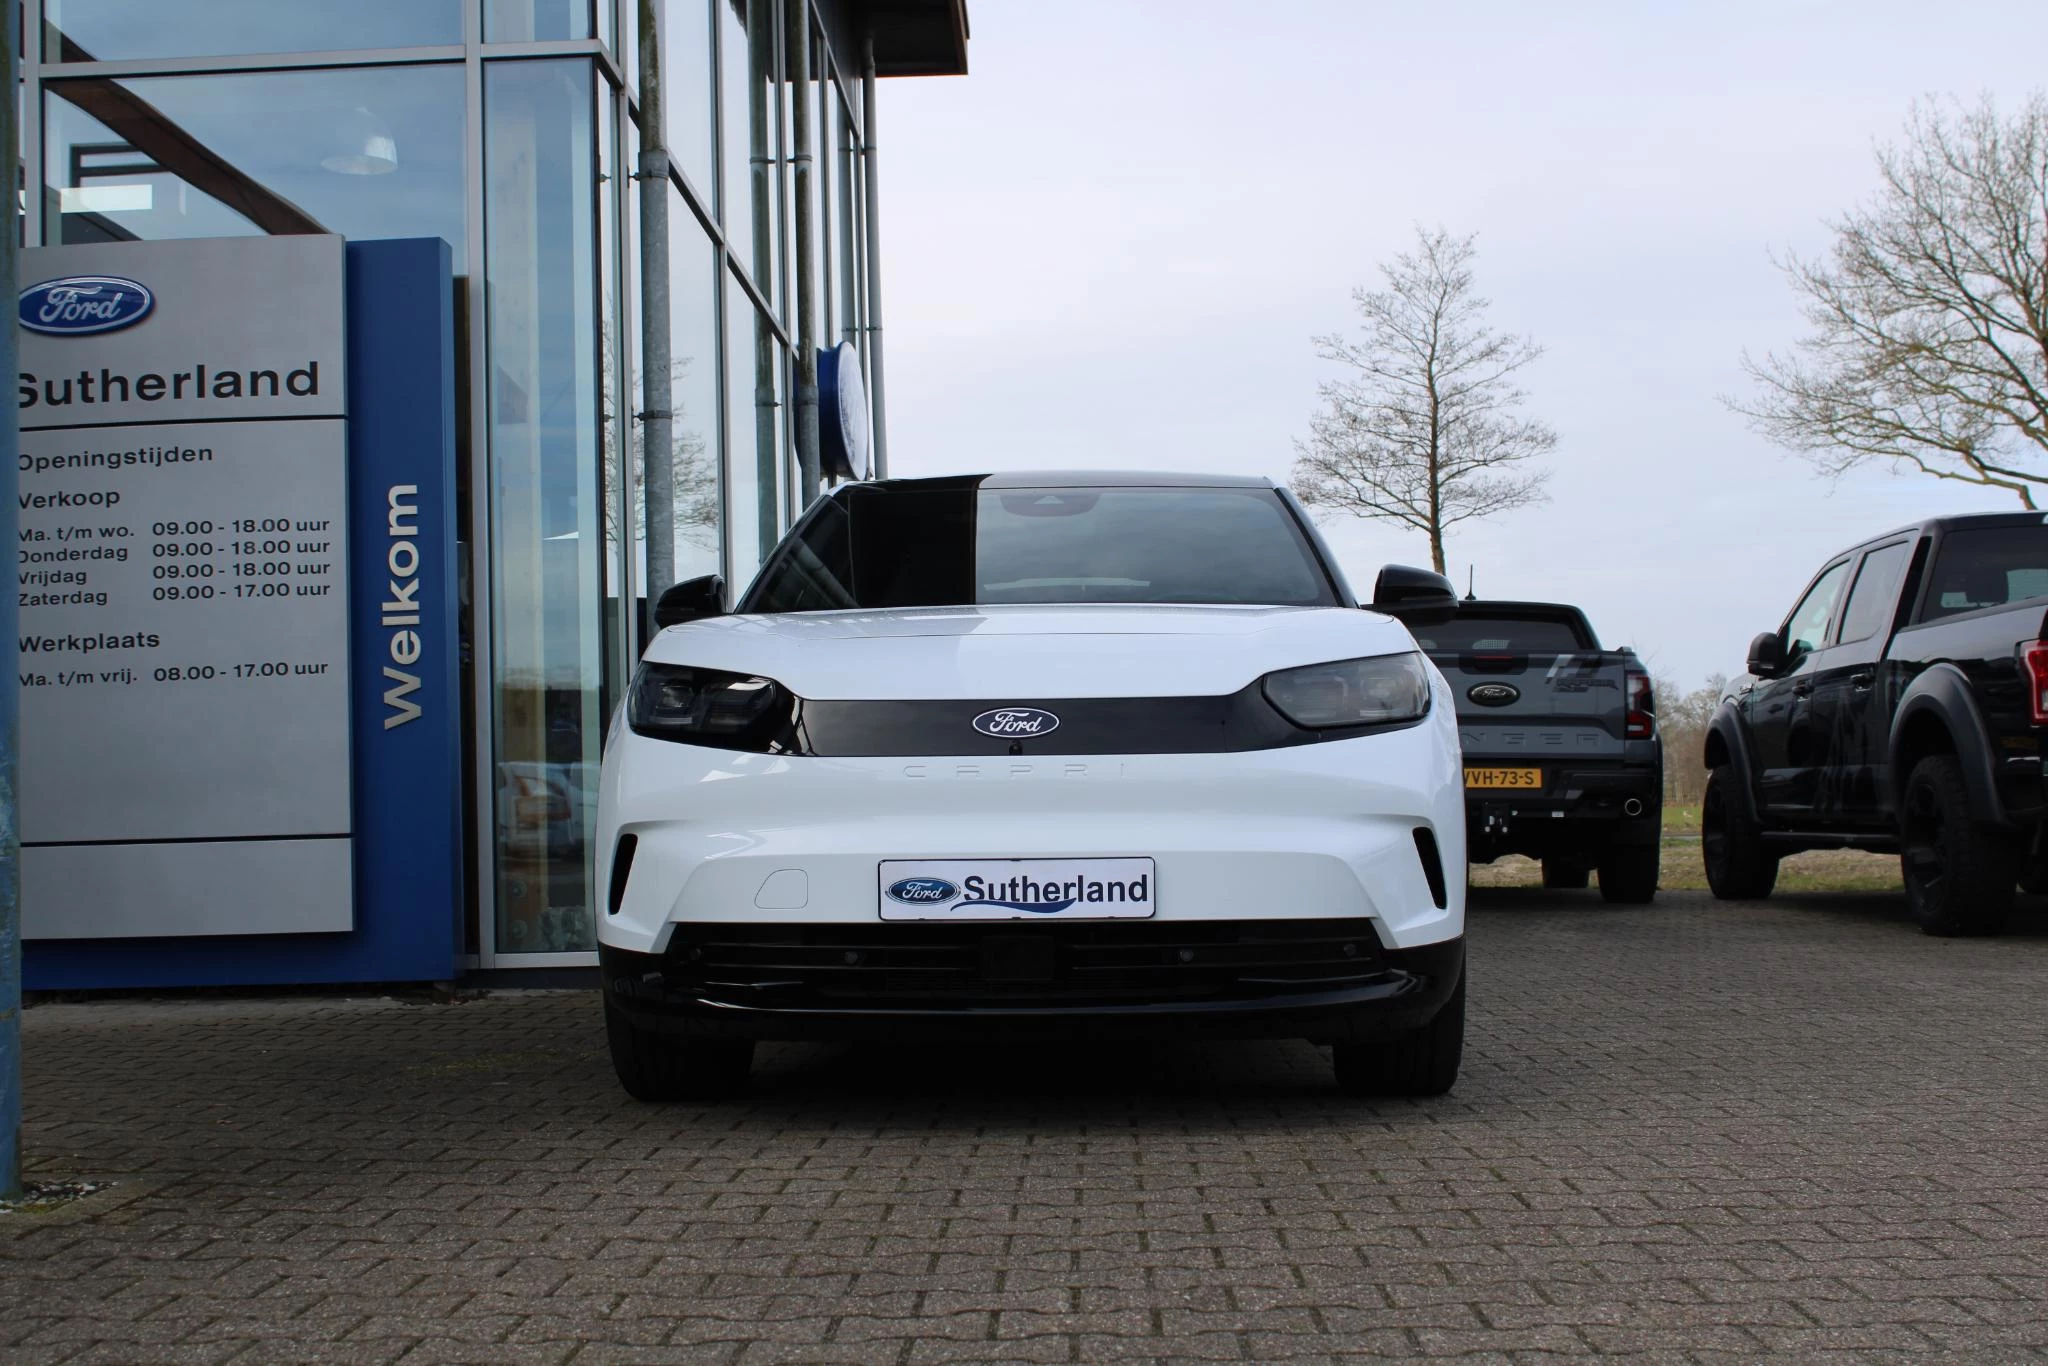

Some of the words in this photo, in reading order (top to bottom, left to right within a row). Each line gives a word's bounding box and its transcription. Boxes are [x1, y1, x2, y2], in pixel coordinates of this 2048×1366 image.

[39, 286, 123, 323] Ford
[19, 361, 319, 409] Sutherland
[19, 446, 213, 473] Openingstijden
[19, 491, 121, 509] Verkoop
[56, 526, 92, 542] t/m
[99, 526, 135, 538] wo.
[152, 520, 213, 536] 09.00
[232, 518, 290, 534] 18.00
[296, 519, 330, 532] uur
[19, 547, 128, 563] Donderdag
[152, 542, 213, 557] 09.00
[231, 540, 291, 556] 18.00
[296, 541, 330, 553] uur
[19, 570, 87, 587] Vrijdag
[153, 564, 214, 579] 09.00
[232, 561, 291, 577] 18.00
[297, 562, 330, 575] uur
[19, 591, 108, 606] Zaterdag
[153, 585, 214, 600] 09.00
[234, 583, 290, 598] 17.00
[296, 584, 330, 596] uur
[381, 484, 422, 731] Welkom
[19, 632, 160, 654] Werkplaats
[57, 671, 94, 687] t/m
[100, 668, 137, 685] vrij.
[154, 665, 215, 682] 08.00
[233, 662, 289, 678] 17.00
[294, 663, 328, 675] uur
[989, 710, 1043, 733] Ford
[902, 763, 1125, 779] CAPRI
[901, 881, 943, 900] Ford
[963, 875, 1148, 903] Sutherland
